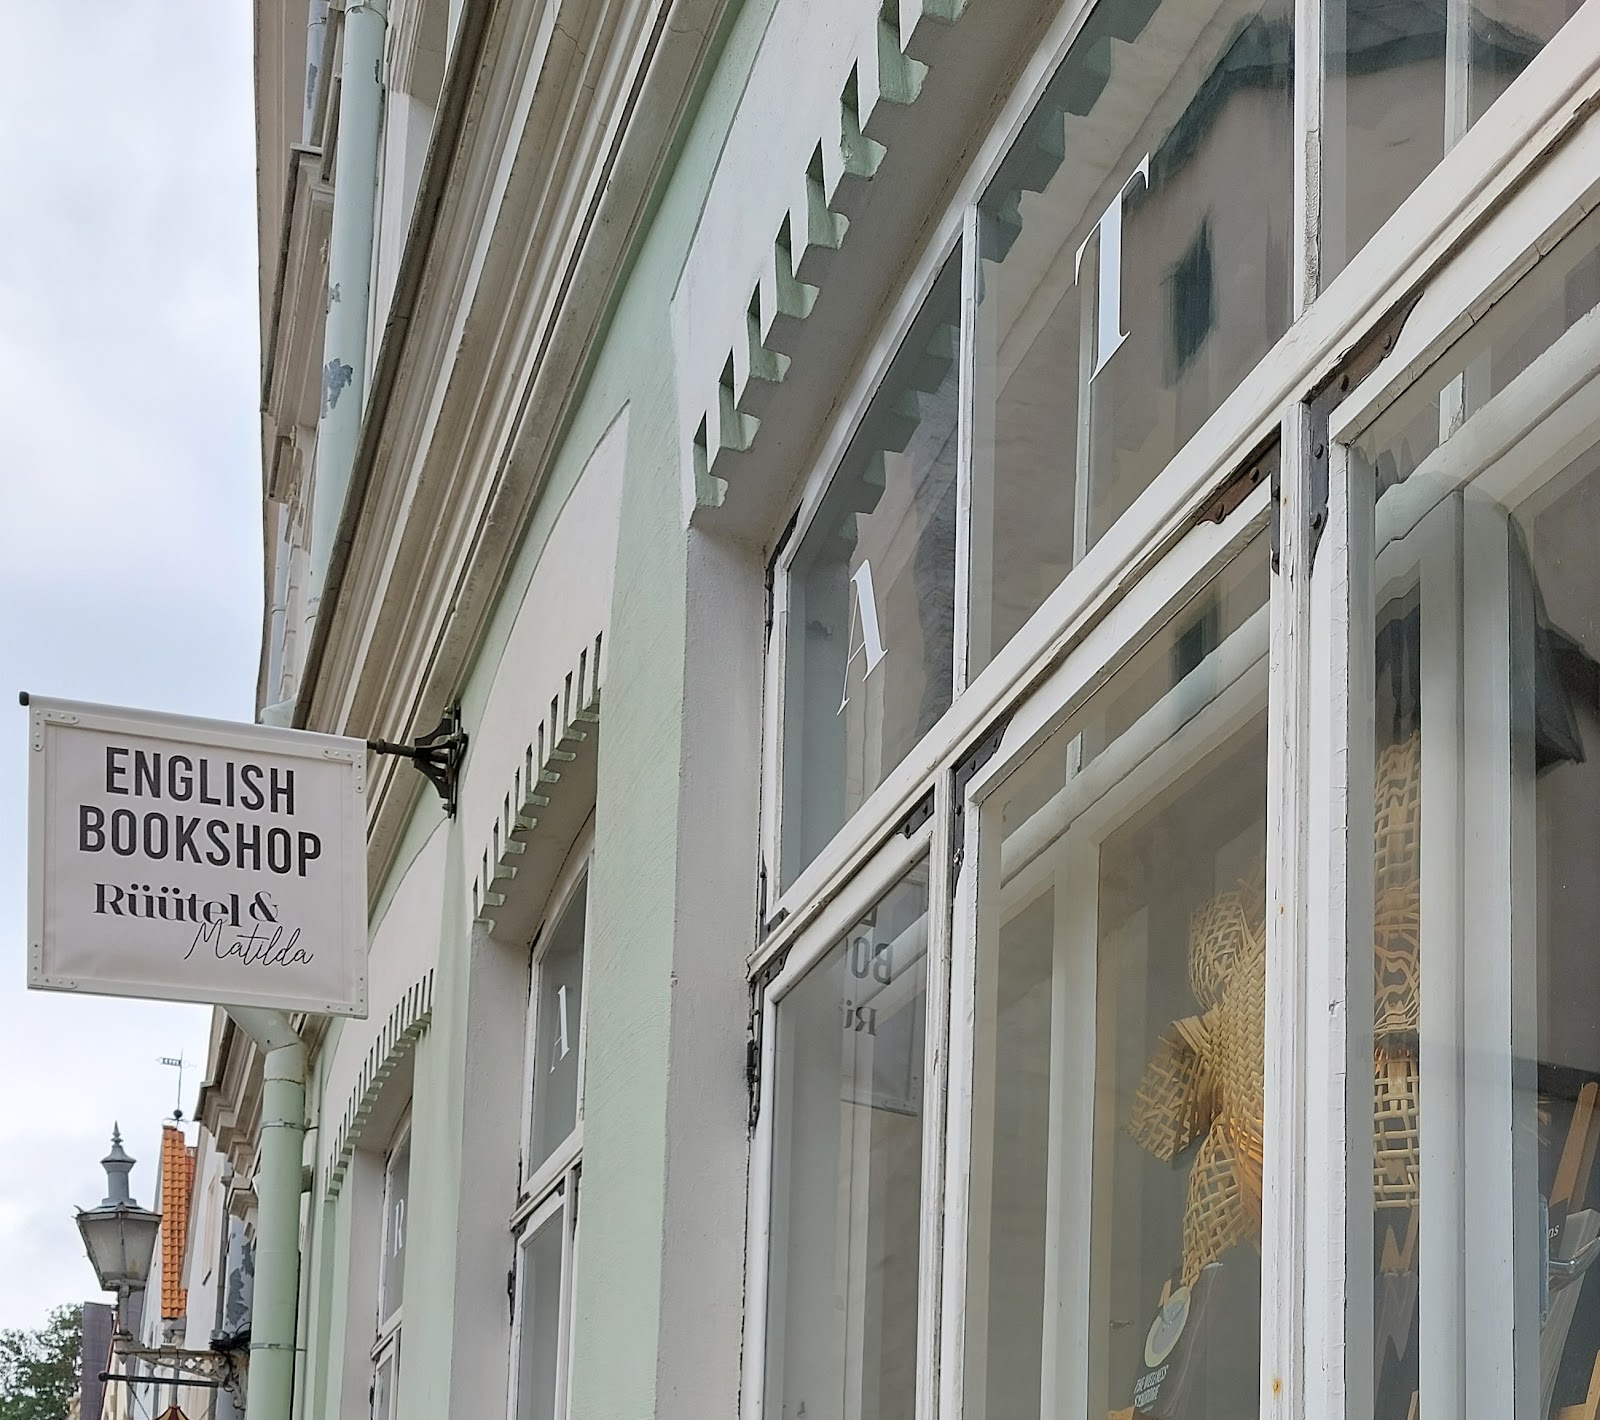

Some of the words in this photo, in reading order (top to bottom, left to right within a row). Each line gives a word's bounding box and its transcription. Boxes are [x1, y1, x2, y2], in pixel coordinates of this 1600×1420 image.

[1074, 152, 1150, 385] T
[835, 559, 889, 717] A
[106, 746, 295, 816] ENGLISH
[79, 804, 321, 877] BOOKSHOP
[94, 883, 240, 928] Rüütel
[249, 891, 278, 923] &
[184, 918, 315, 967] Matilda
[549, 985, 571, 1075] A
[393, 1199, 406, 1259] R
